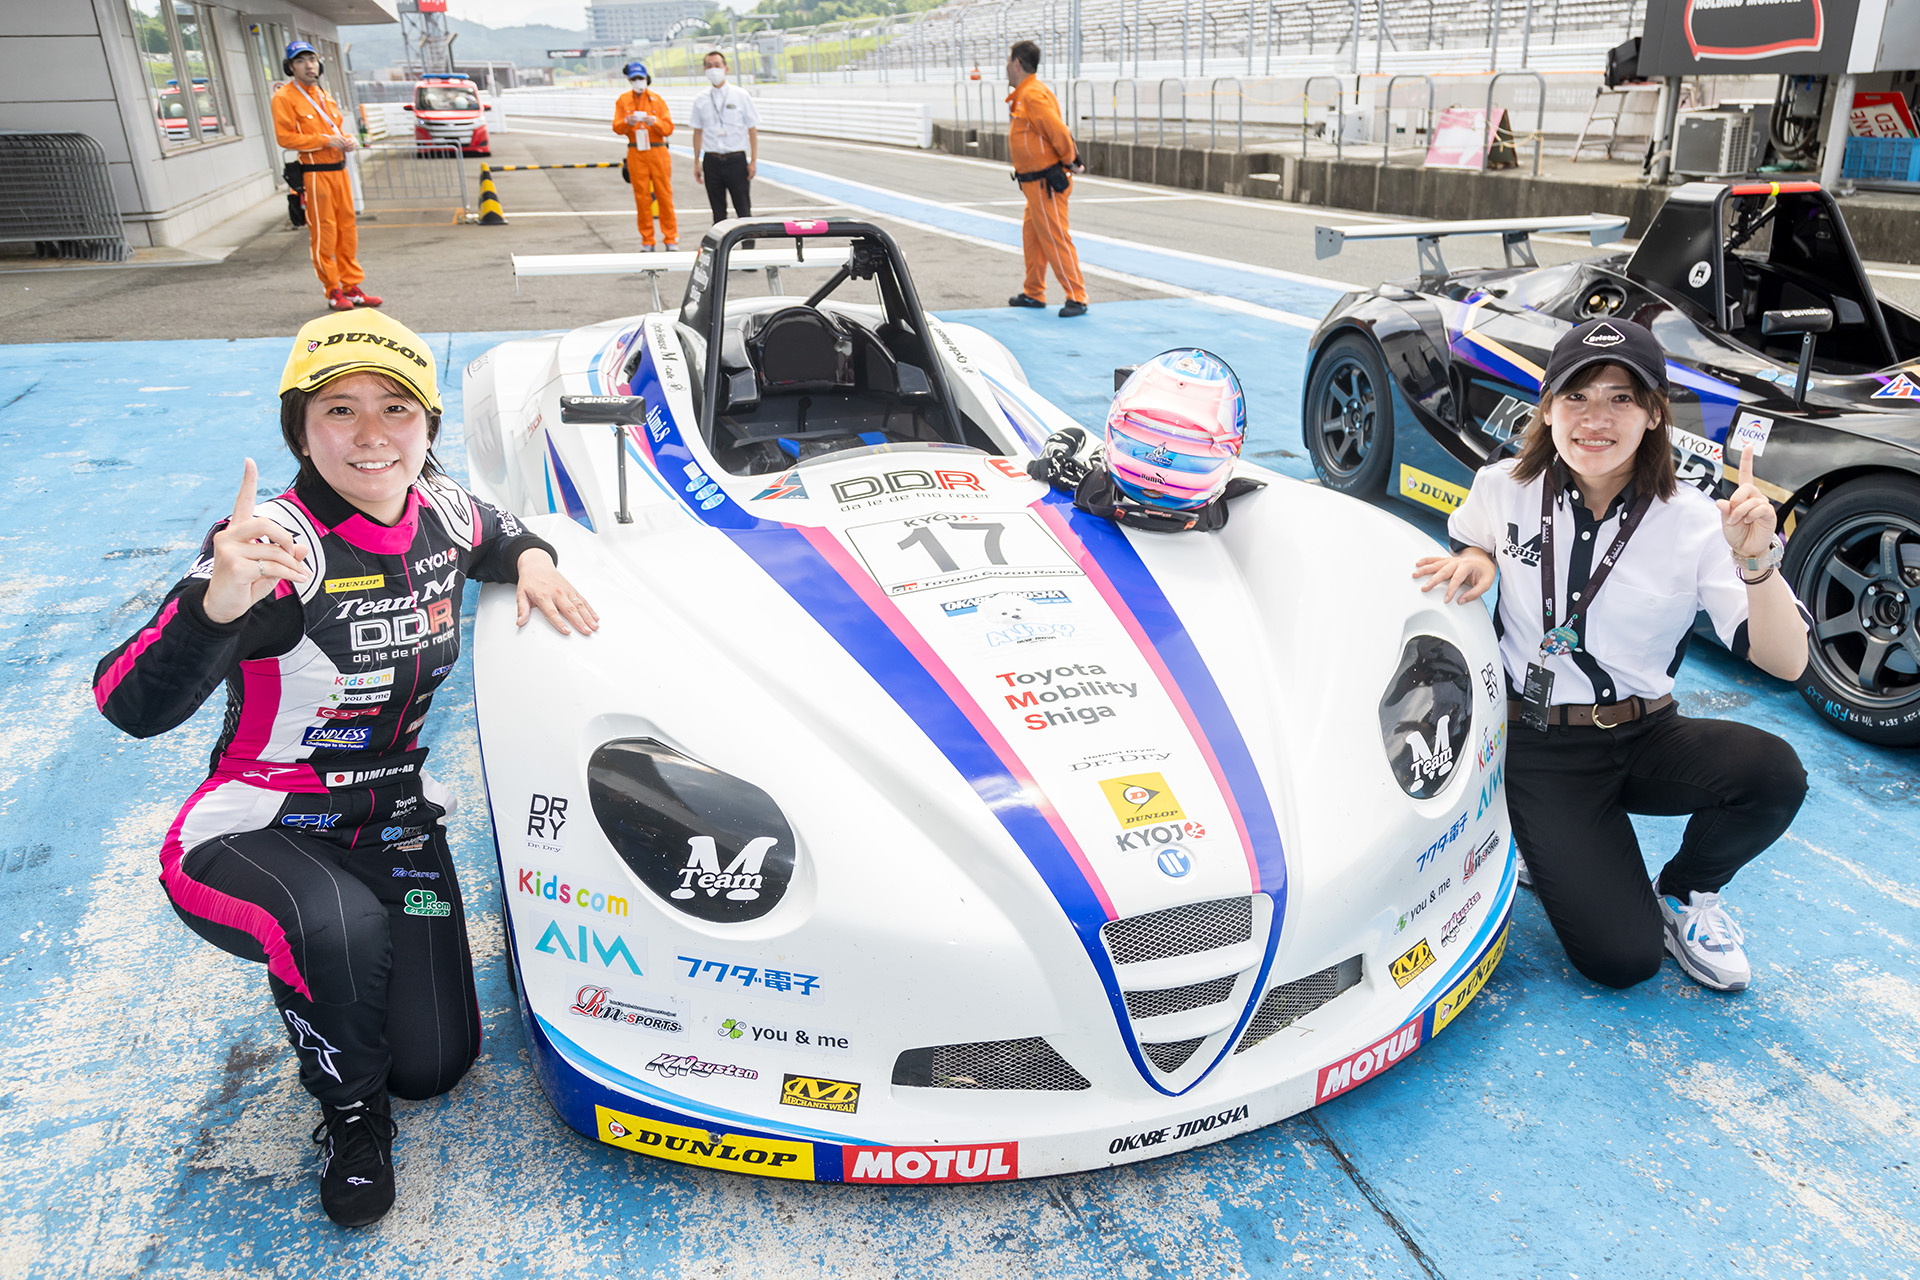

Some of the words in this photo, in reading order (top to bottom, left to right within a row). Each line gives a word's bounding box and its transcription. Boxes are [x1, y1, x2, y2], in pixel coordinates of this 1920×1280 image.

[1782, 308, 1829, 318] G-SHOCK
[324, 333, 428, 368] DUNLOP
[570, 396, 629, 404] G-SHOCK
[1737, 427, 1767, 441] FUCHS
[896, 522, 1009, 573] 17
[335, 590, 418, 620] Team
[416, 568, 458, 602] M
[338, 577, 380, 590] DUNLOP
[353, 653, 370, 663] da
[376, 650, 388, 662] le
[391, 647, 409, 659] de
[996, 663, 1107, 687] Toyota
[1004, 681, 1138, 710] Mobility
[1024, 706, 1116, 731] Shiga
[308, 728, 369, 741] ENDLESS
[1068, 759, 1112, 772] Dr.
[1119, 751, 1172, 764] Dry
[1411, 747, 1454, 781] Team
[354, 767, 385, 784] AIMI
[530, 793, 568, 820] DR
[1126, 810, 1178, 824] DUNLOP
[527, 815, 566, 840] RY
[679, 868, 763, 889] Team
[519, 868, 571, 904] Kids
[577, 888, 628, 917] com
[1410, 901, 1427, 922] you
[1429, 890, 1437, 903] &
[1438, 877, 1451, 896] me
[535, 919, 643, 976] AIM
[677, 955, 820, 996] フクダ電子
[752, 1026, 787, 1042] you
[795, 1029, 810, 1045] &
[817, 1033, 849, 1049] me
[1321, 1023, 1417, 1099] MOTUL
[782, 1093, 832, 1110] MECHANIX
[832, 1102, 856, 1114] WEAR
[1109, 1127, 1171, 1155] OKABE
[1172, 1104, 1249, 1140] JIDOSHA
[636, 1127, 798, 1168] DUNLOP
[852, 1148, 1011, 1180] MOTUL
